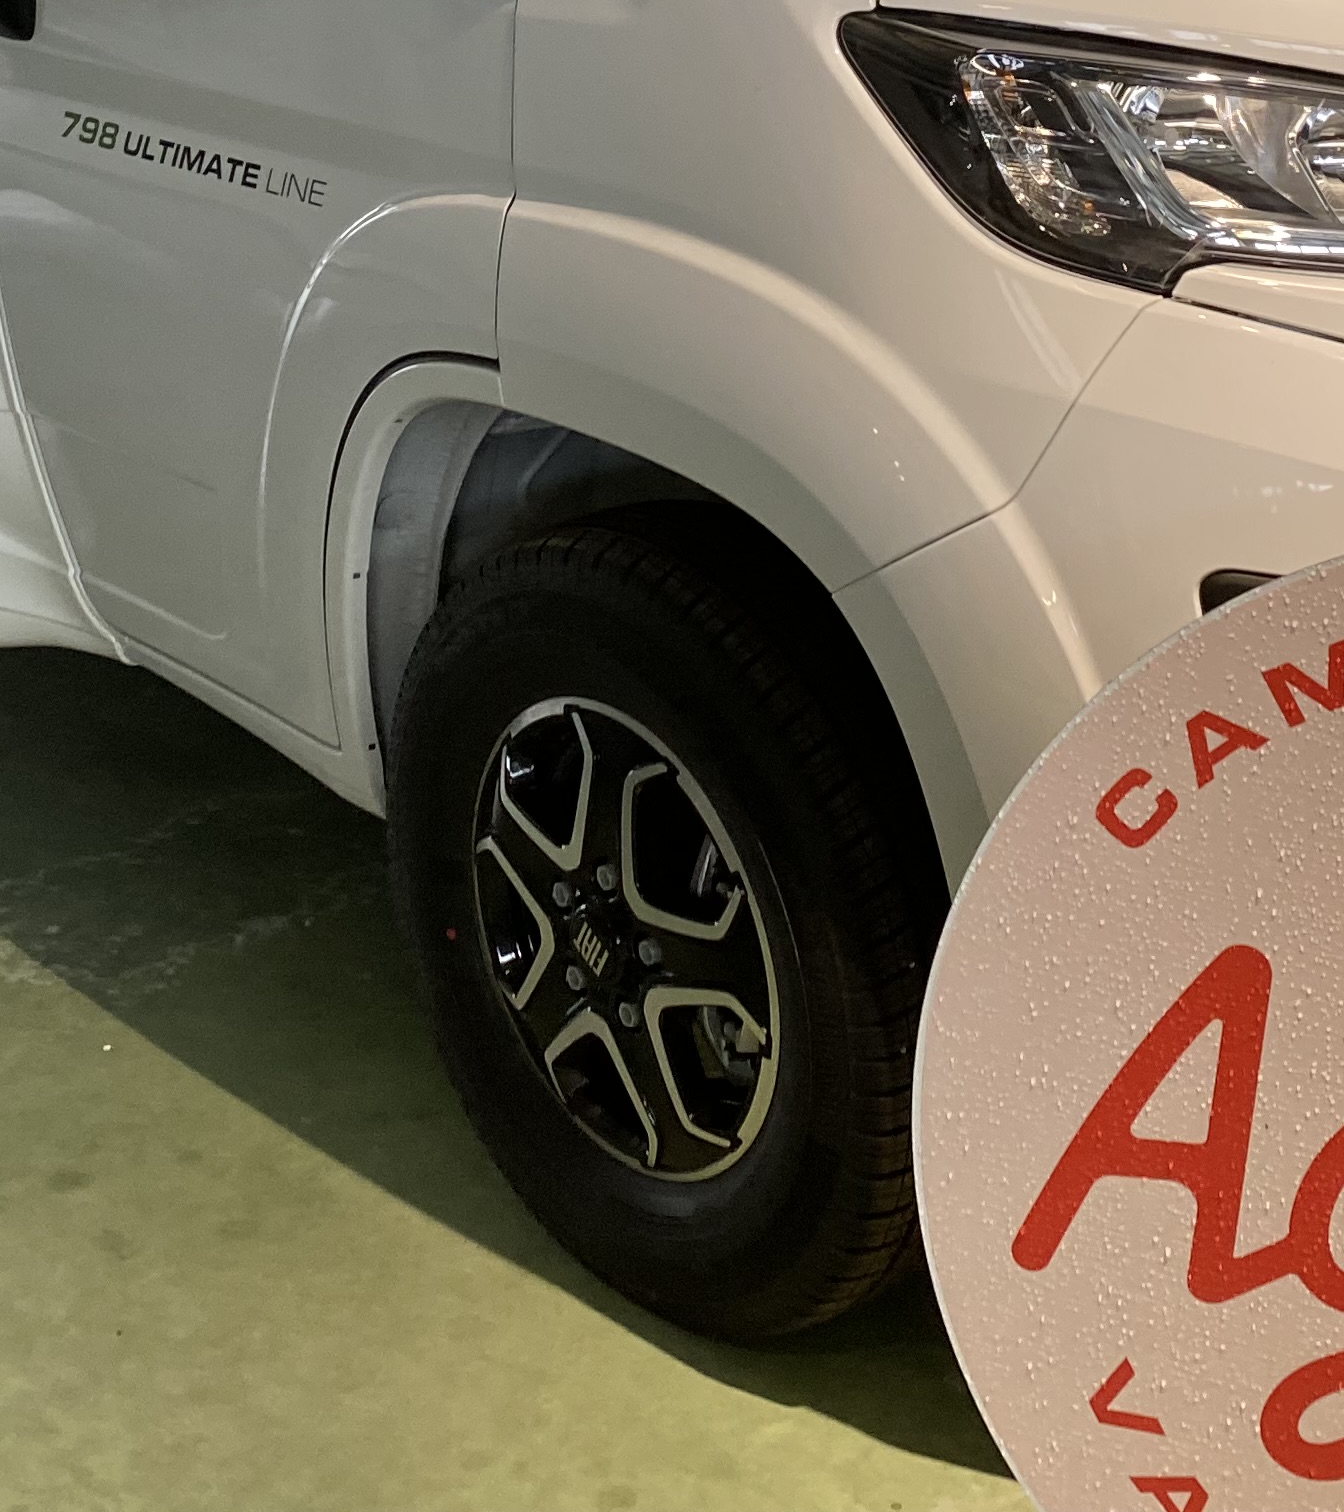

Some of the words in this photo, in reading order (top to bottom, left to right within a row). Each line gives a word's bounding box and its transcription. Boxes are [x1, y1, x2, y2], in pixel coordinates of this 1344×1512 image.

[60, 110, 120, 151] 798
[123, 130, 262, 190] ULTIMATE
[265, 167, 329, 208] LINE
[573, 921, 609, 977] FIAT
